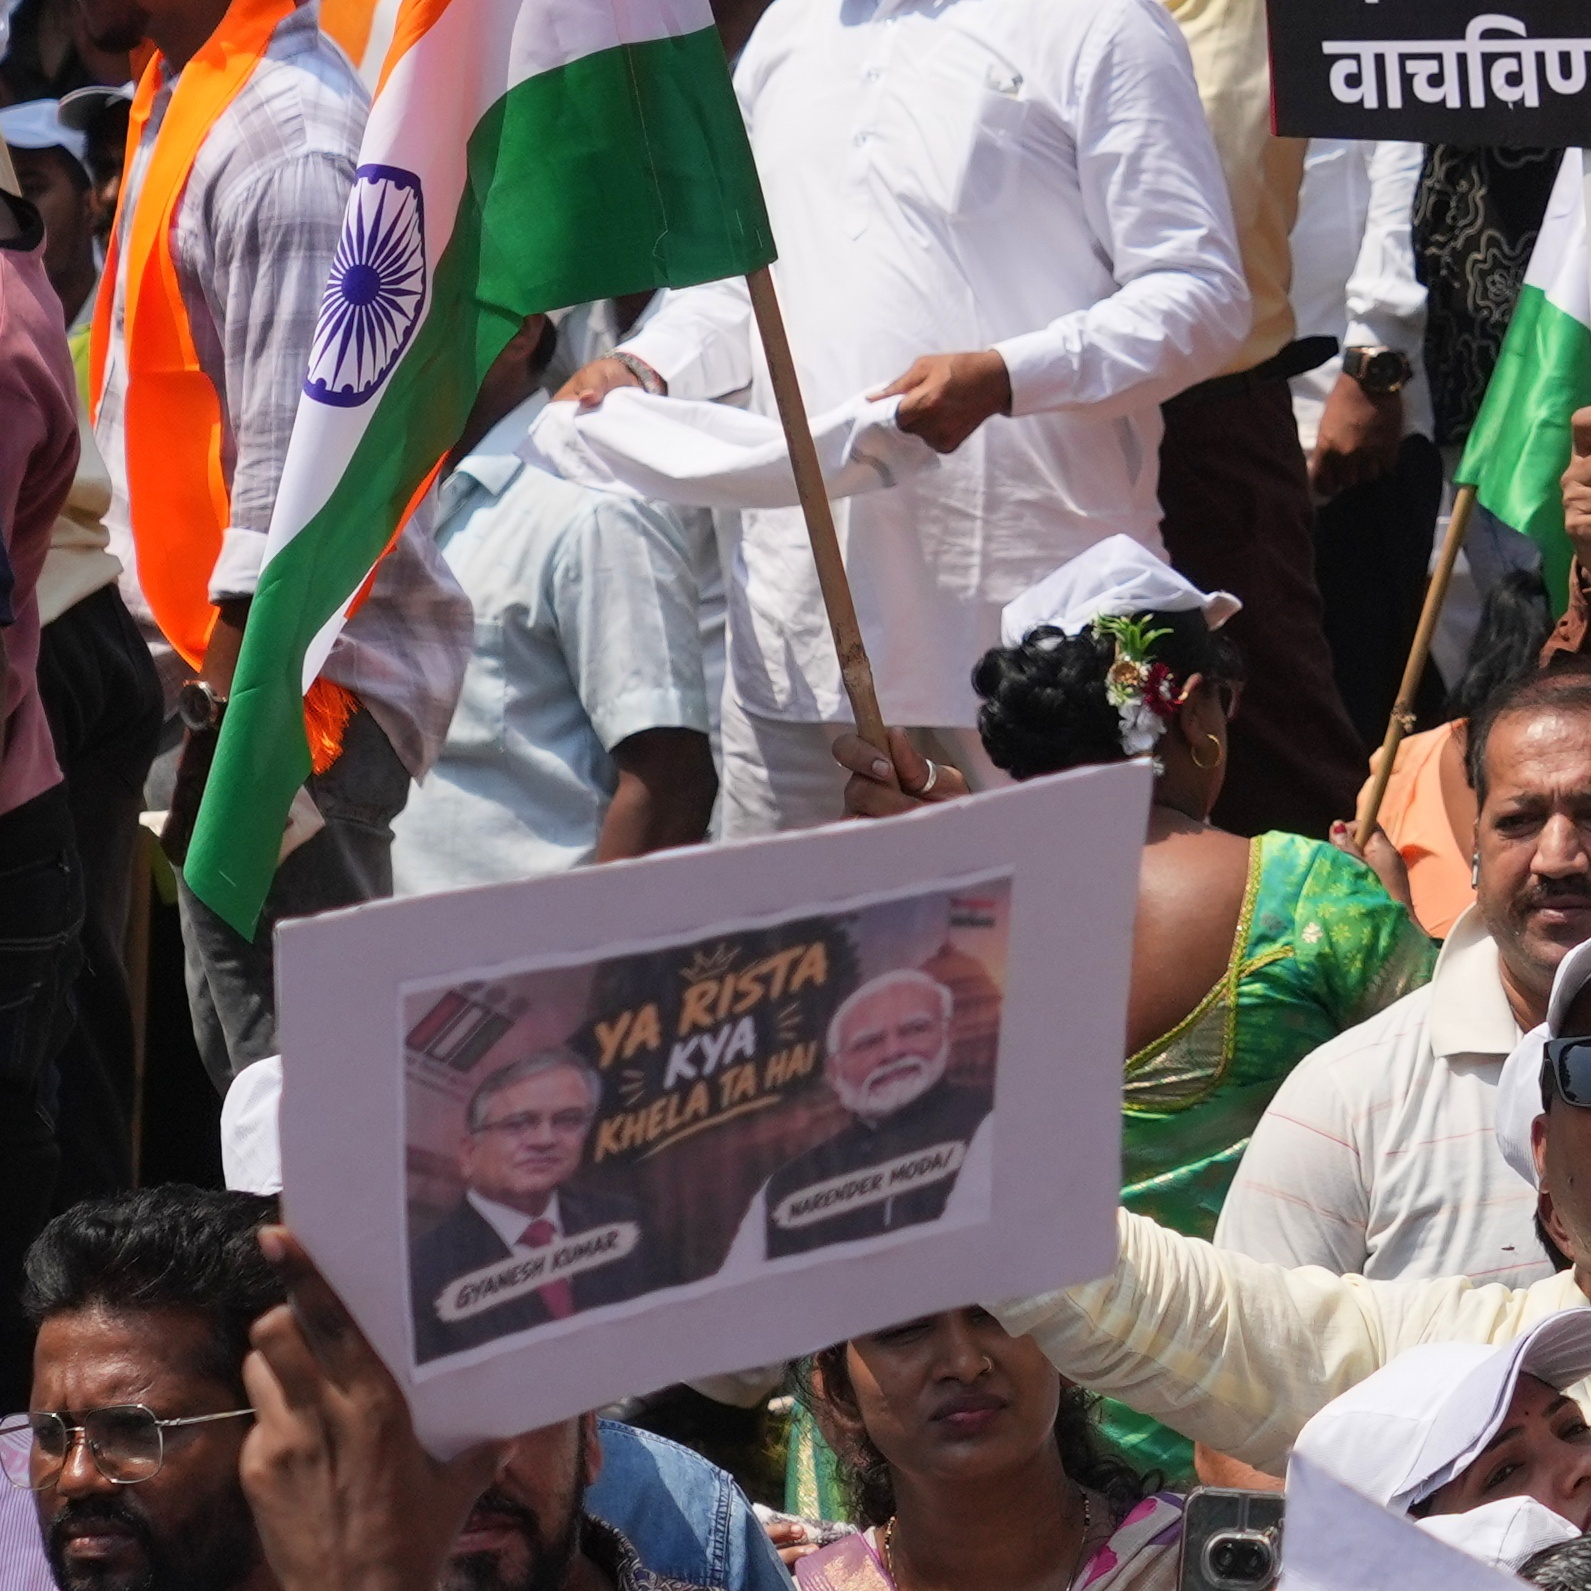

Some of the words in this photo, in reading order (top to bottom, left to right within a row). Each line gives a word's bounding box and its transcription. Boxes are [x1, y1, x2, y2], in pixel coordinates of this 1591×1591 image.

[594, 1003, 662, 1071] YA
[677, 941, 829, 1037] RISTA
[663, 1015, 758, 1090] KYA
[763, 1039, 818, 1090] HAI
[789, 1173, 884, 1221] NARENDER
[454, 1255, 546, 1310] GYANESH
[551, 1229, 619, 1271] KUMAR
